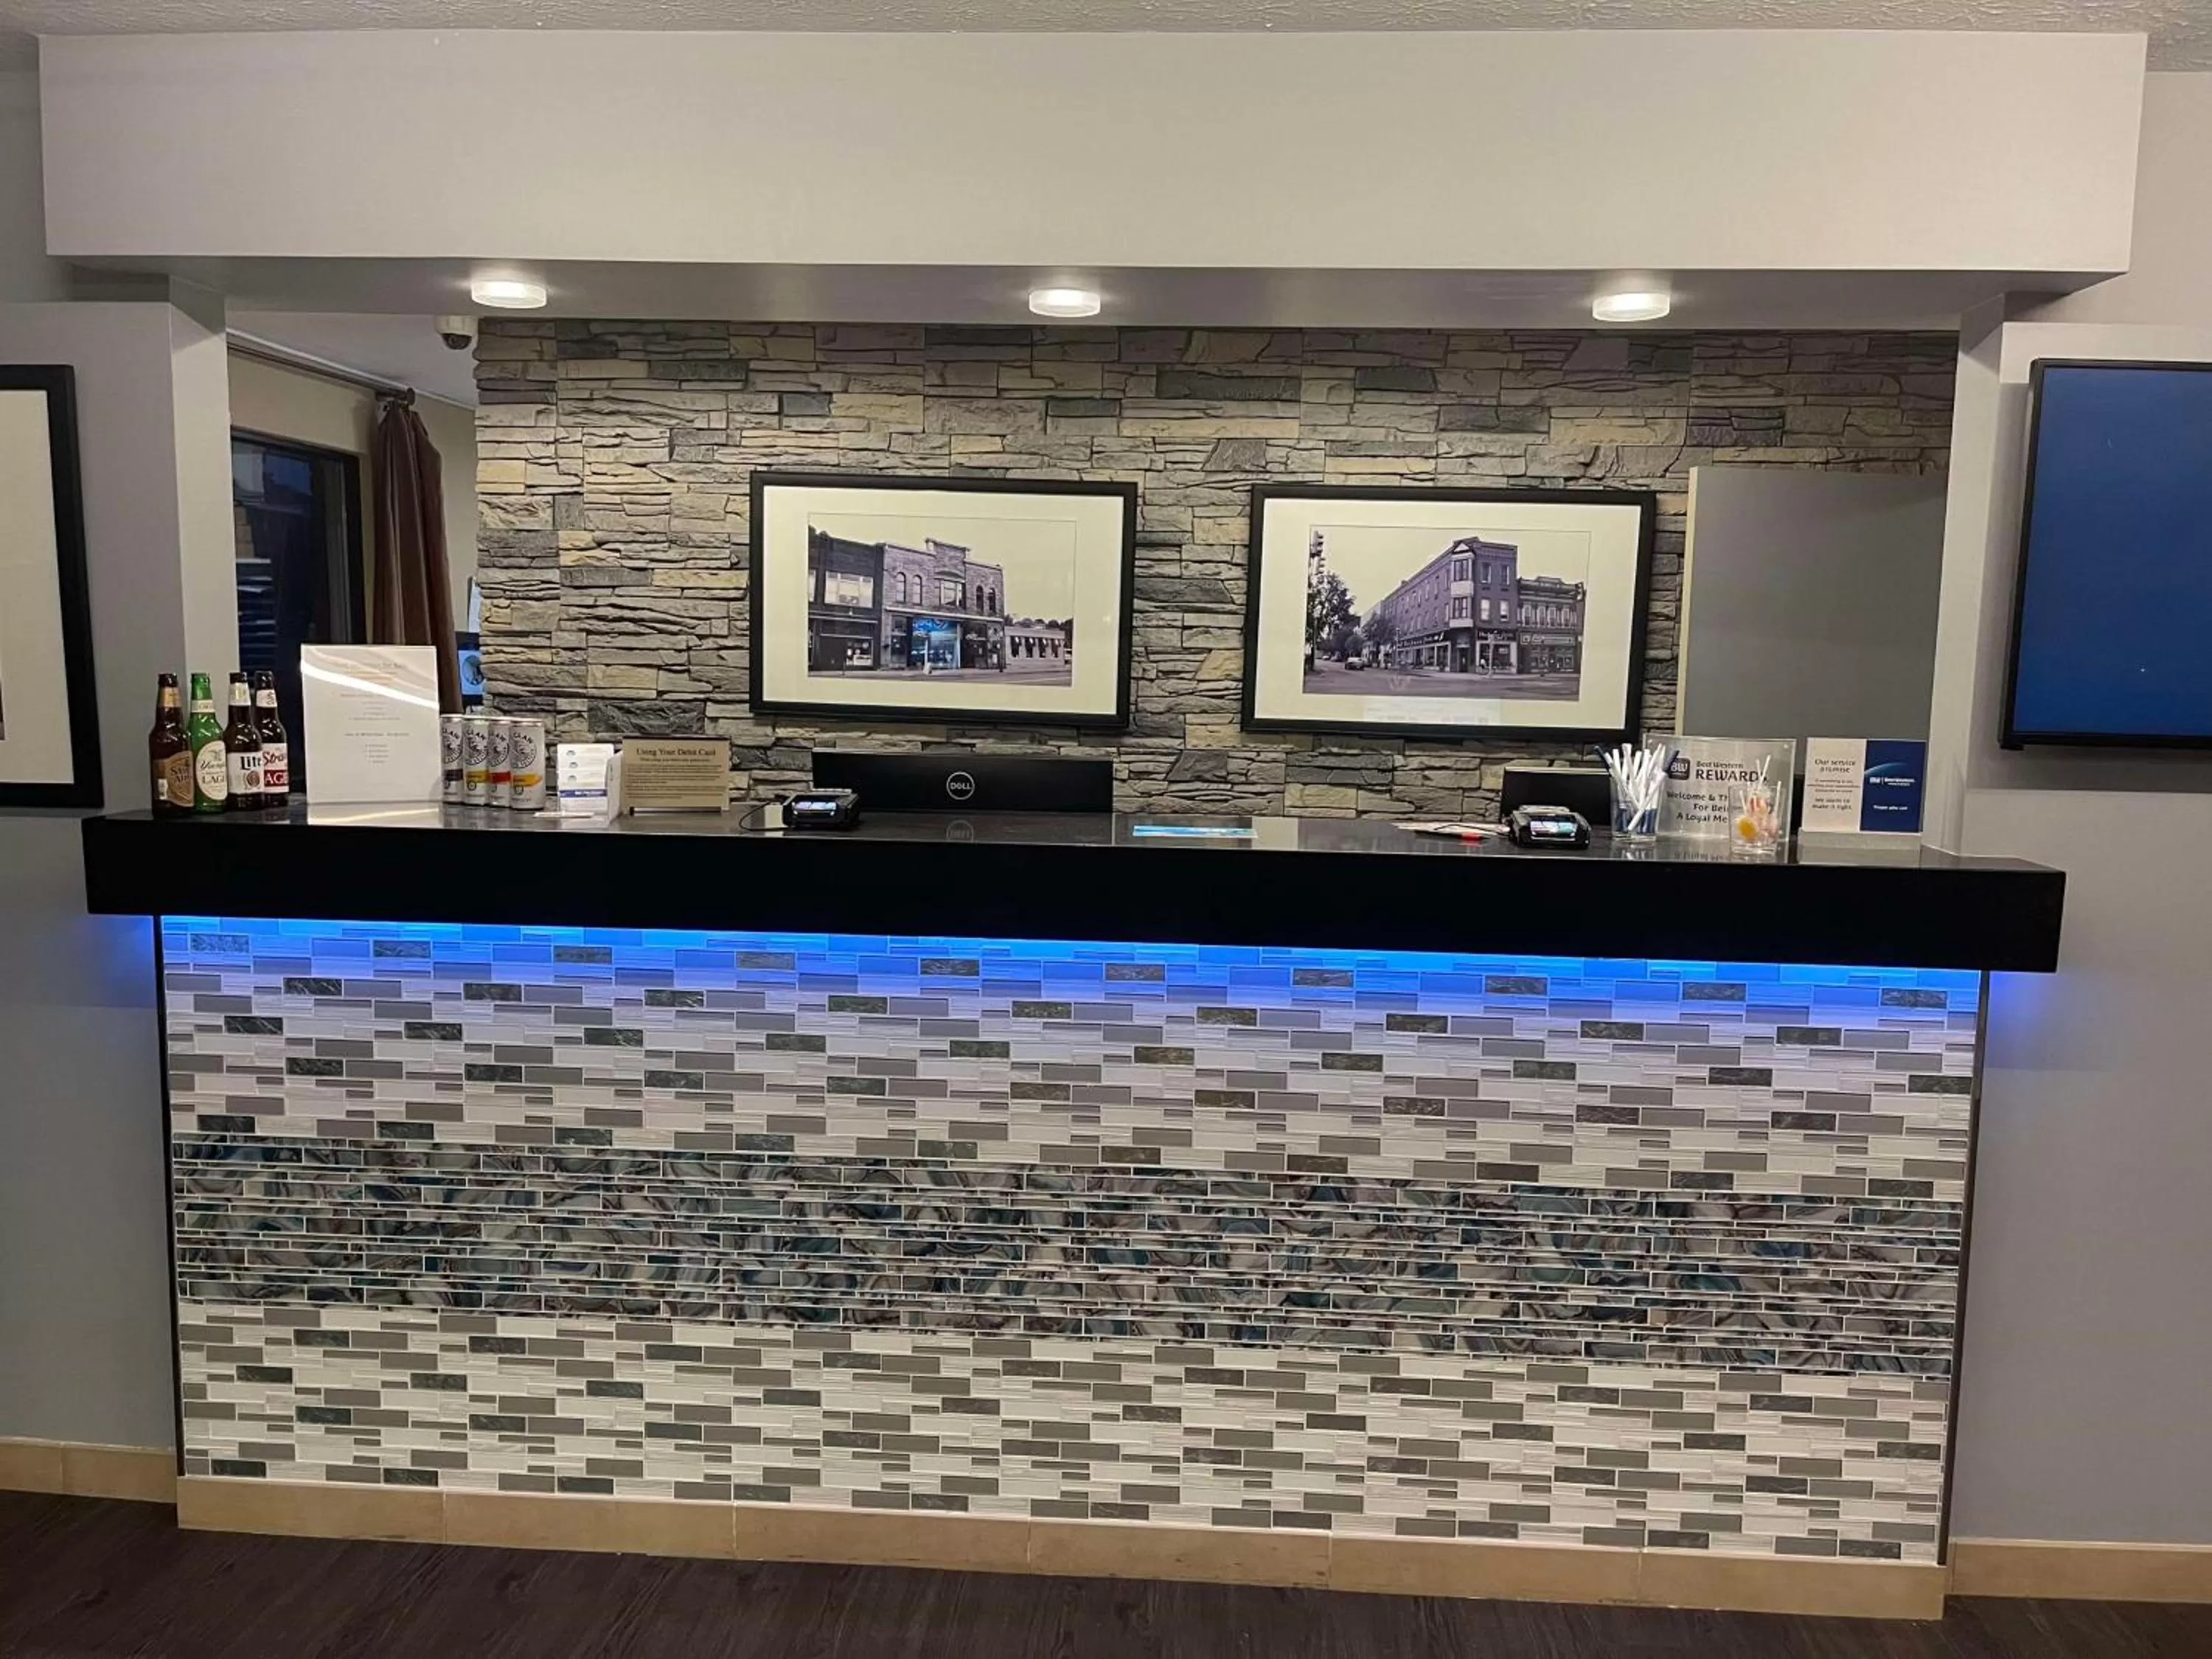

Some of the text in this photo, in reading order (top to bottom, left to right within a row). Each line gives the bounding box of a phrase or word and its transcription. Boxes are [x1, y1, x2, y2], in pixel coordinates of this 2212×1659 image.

[1713, 761, 1744, 769] Western
[1666, 790, 1706, 800] Welcome
[1694, 803, 1728, 813] For Bei
[1676, 812, 1683, 820] A
[1686, 813, 1711, 823] Loyal
